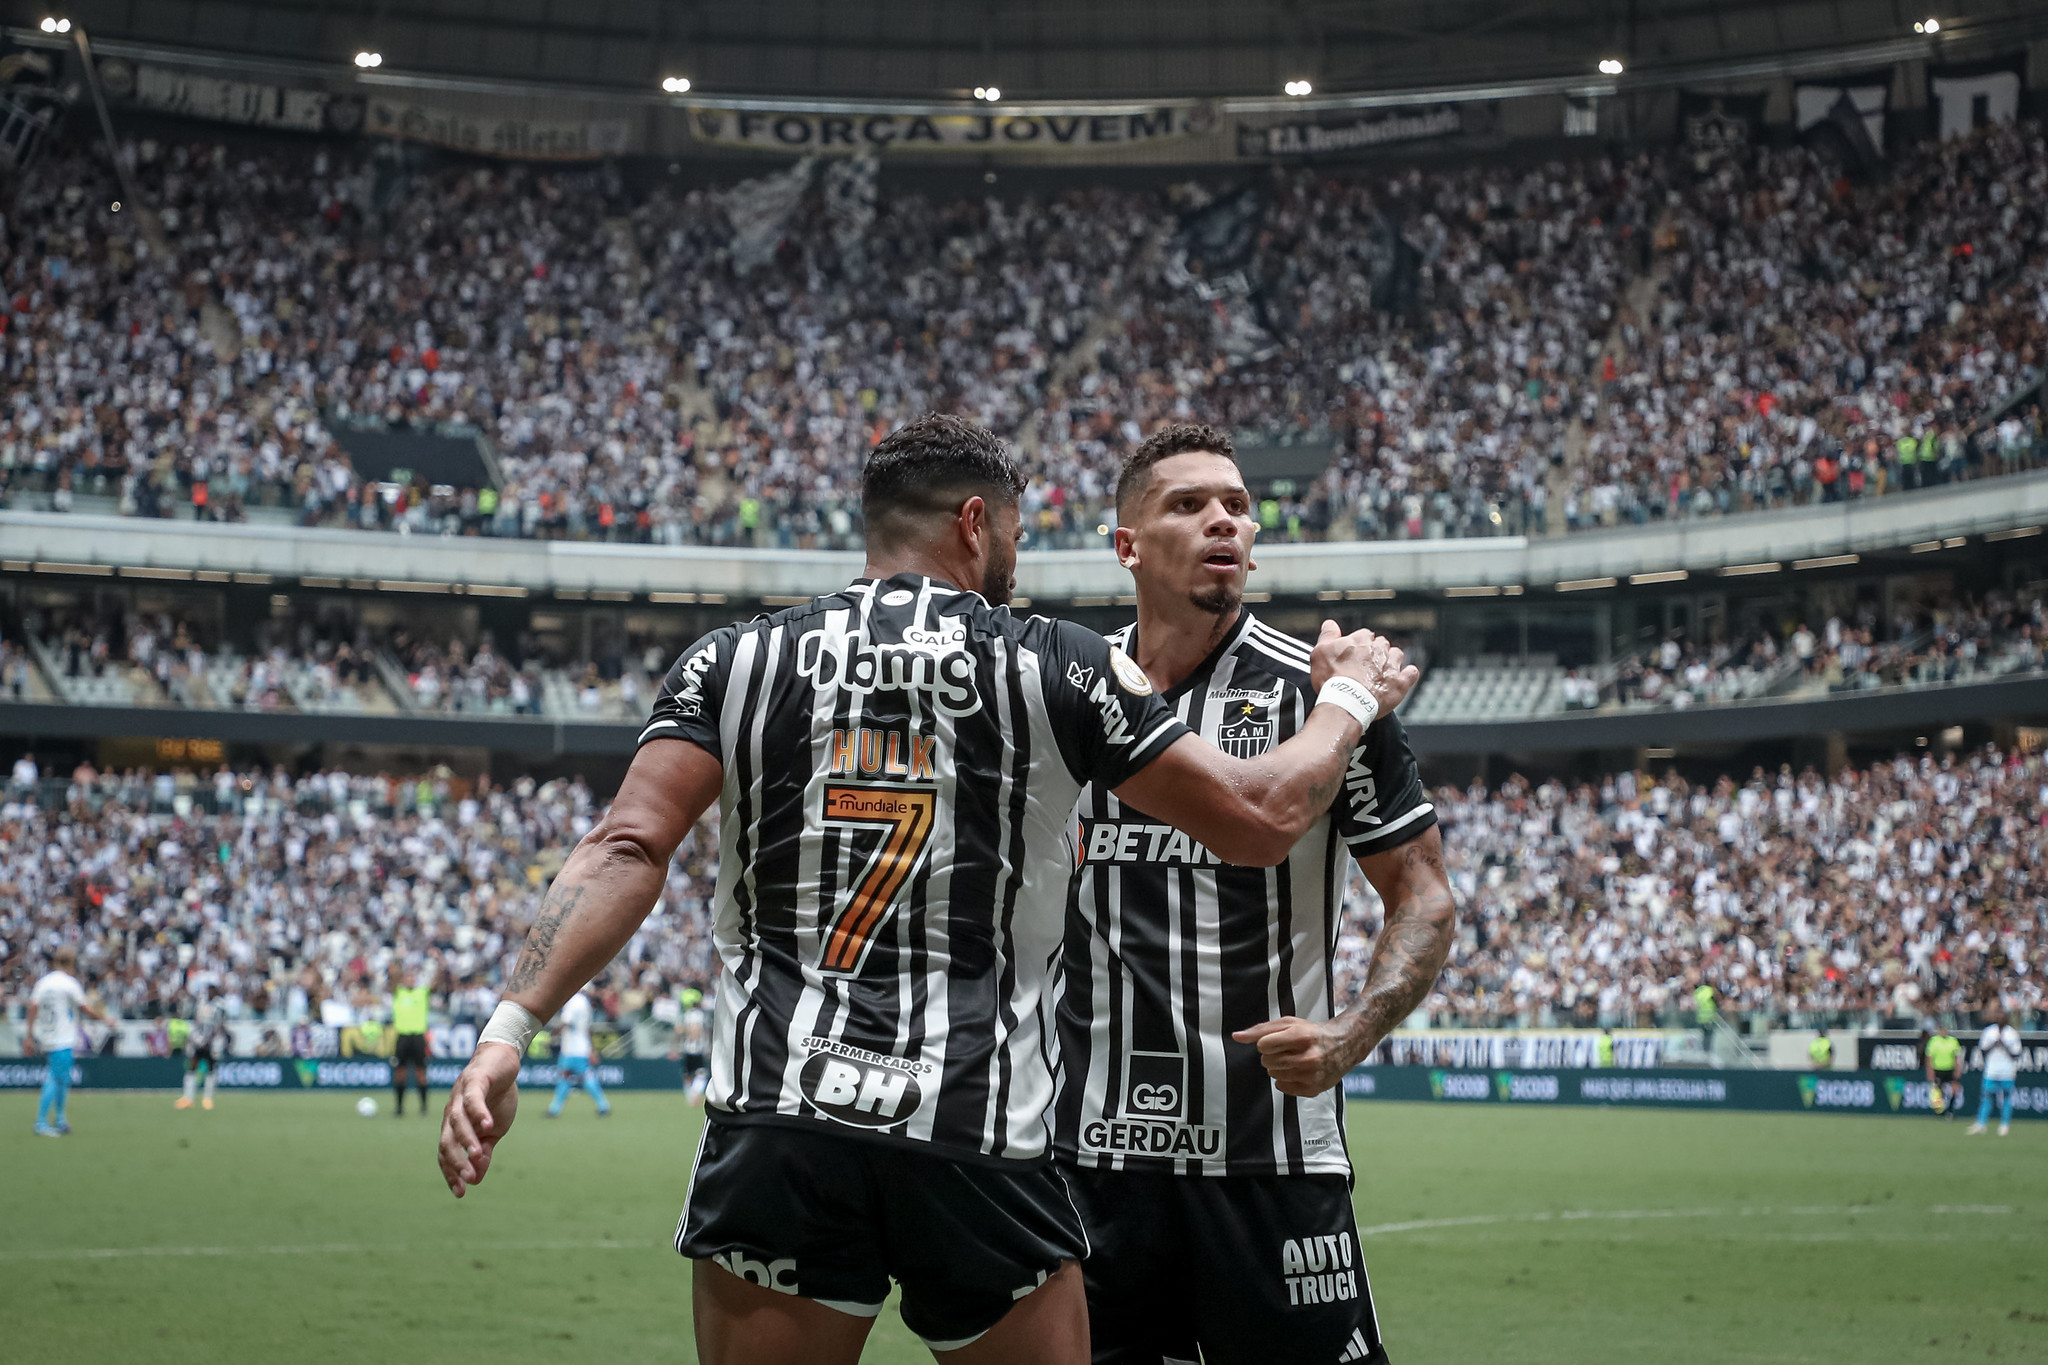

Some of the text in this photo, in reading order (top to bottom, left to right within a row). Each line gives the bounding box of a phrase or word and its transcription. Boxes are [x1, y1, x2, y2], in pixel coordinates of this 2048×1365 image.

[738, 107, 1174, 148] FORÇA JOVEM
[910, 629, 965, 646] GALO
[1089, 677, 1136, 744] MRV
[1208, 683, 1279, 700] Multimarcas
[1226, 726, 1264, 738] CAM
[831, 727, 937, 780] HULK
[1346, 744, 1382, 825] MRV
[839, 797, 908, 814] mundiale
[1087, 823, 1222, 865] BETAN
[818, 782, 942, 978] 7
[800, 1036, 933, 1074] SUPERMERCADOS
[813, 1057, 909, 1118] BH
[1084, 1121, 1220, 1156] GERDAU
[1282, 1231, 1353, 1276] AUTO
[1284, 1270, 1358, 1306] TRUCK
